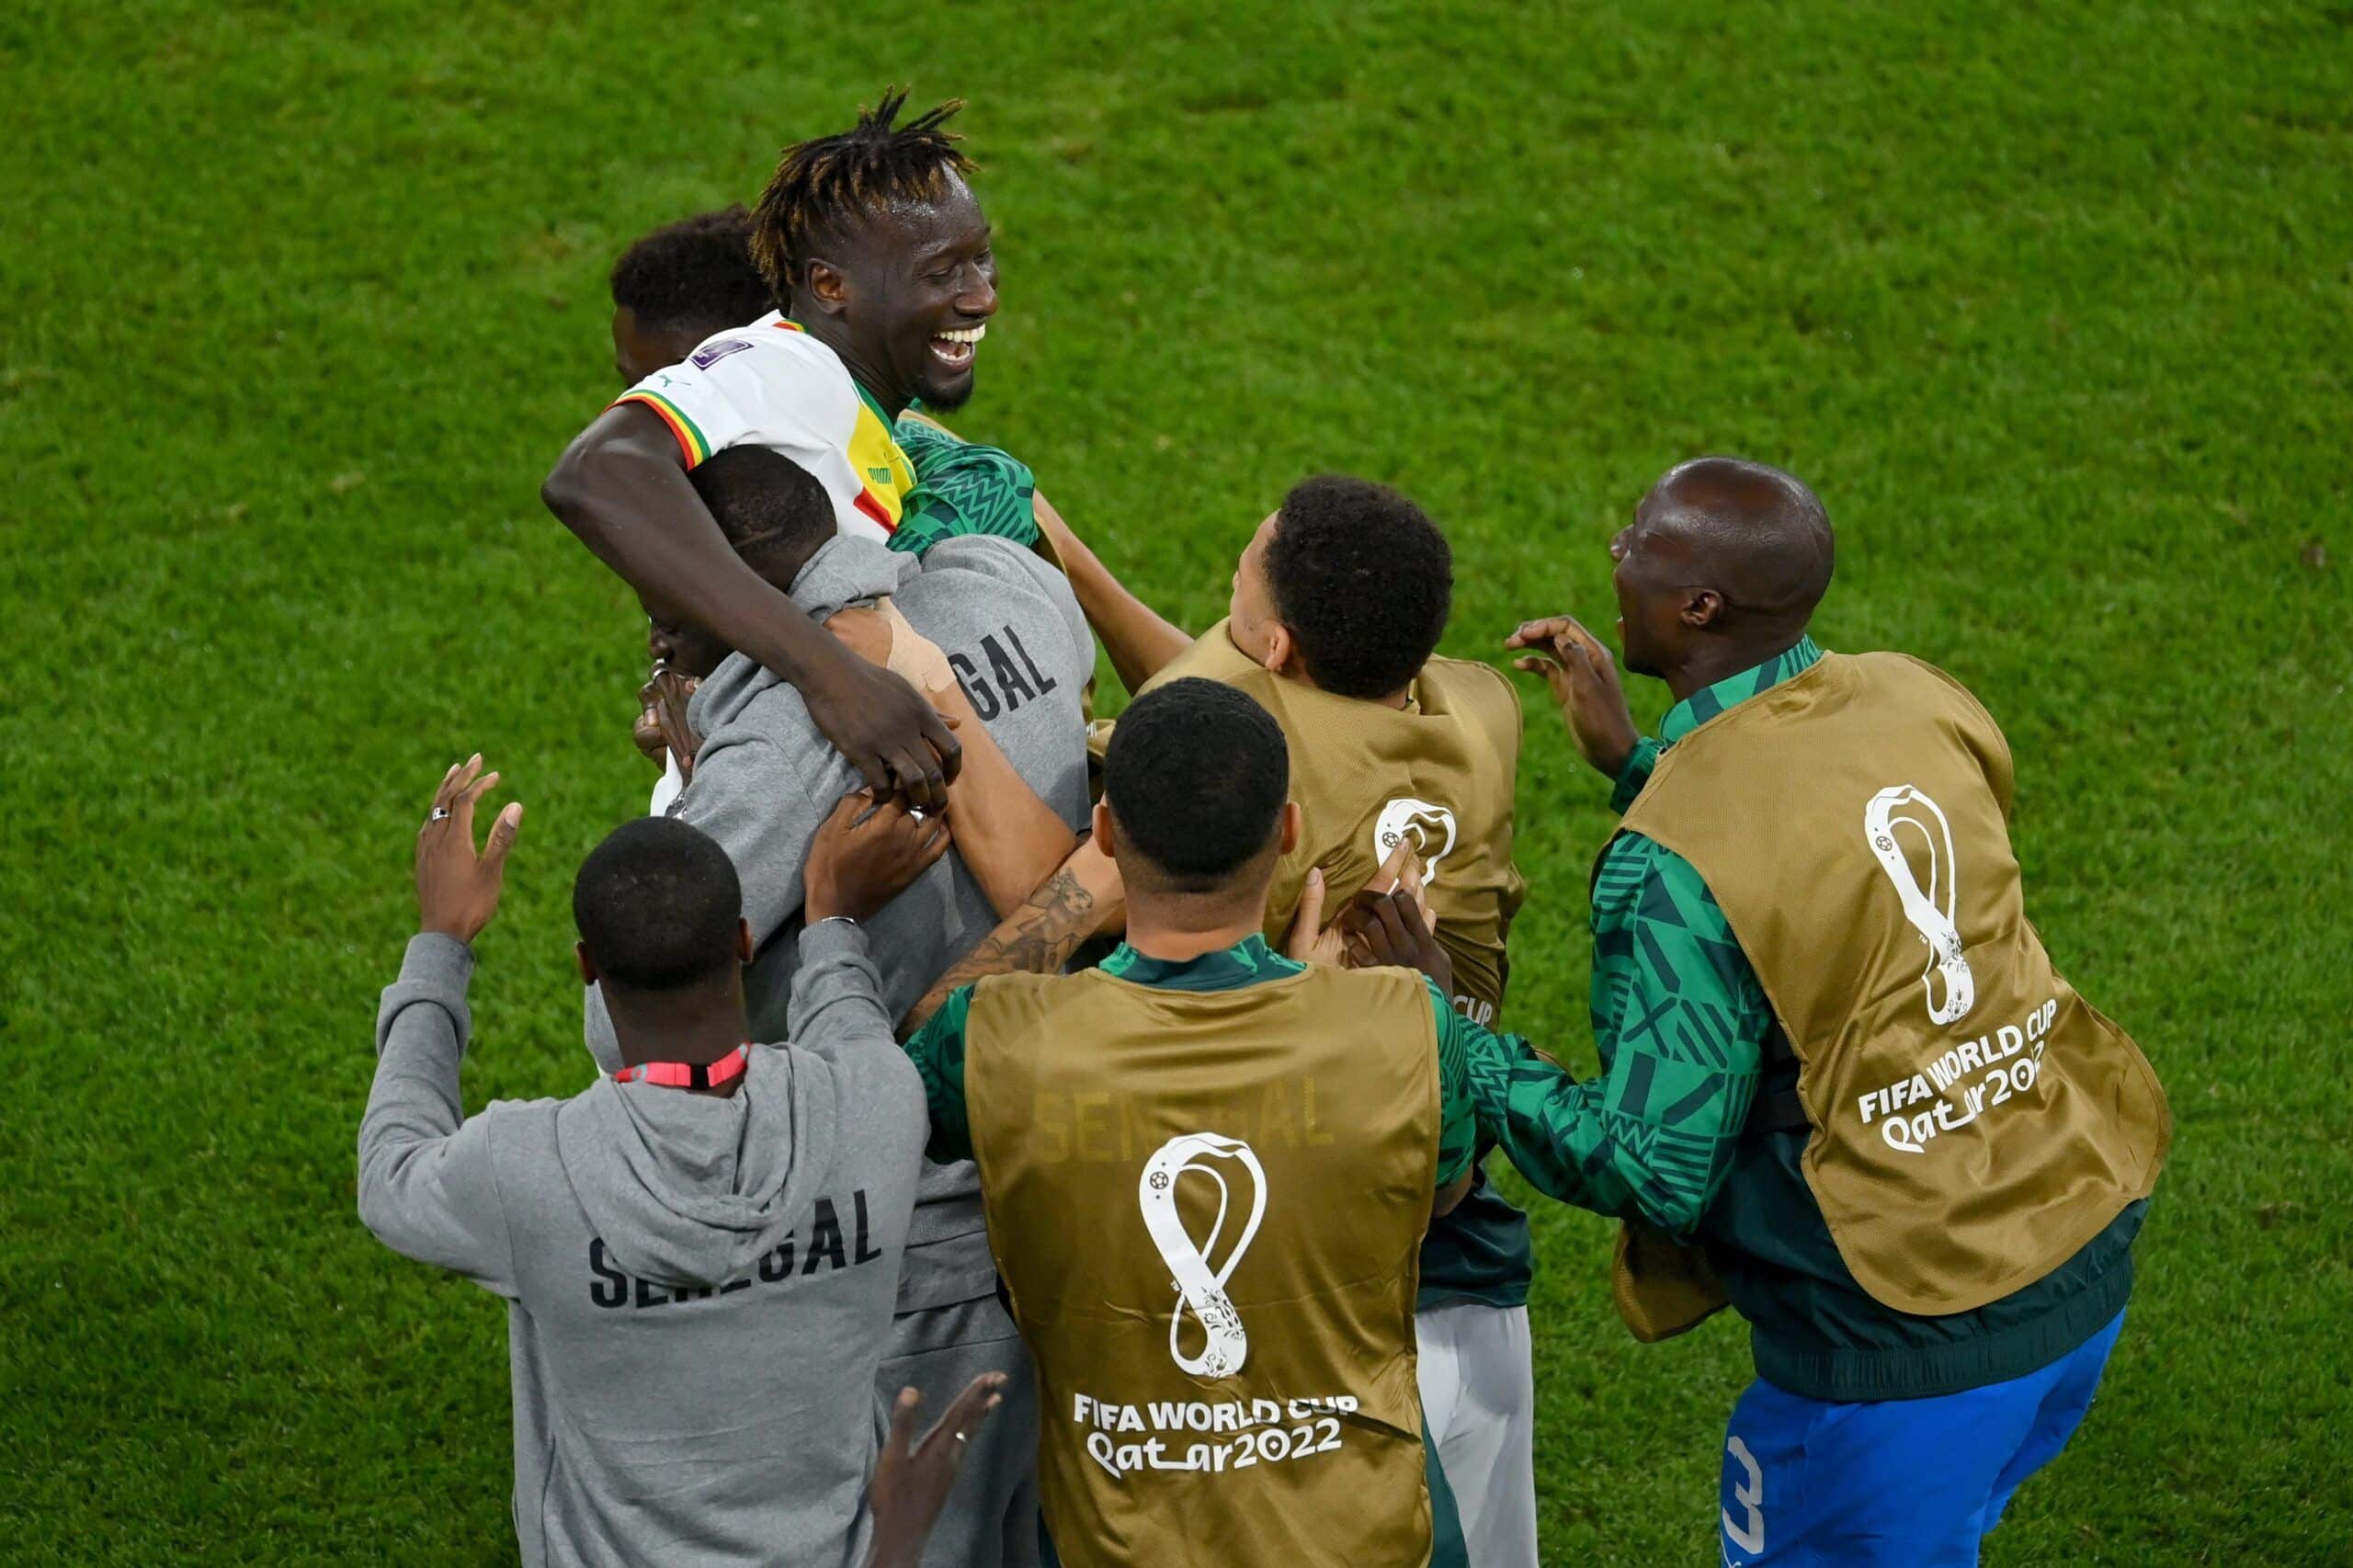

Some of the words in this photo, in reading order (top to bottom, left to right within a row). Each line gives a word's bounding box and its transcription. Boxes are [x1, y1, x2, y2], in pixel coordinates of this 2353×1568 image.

[1858, 1073, 1934, 1124] FIFA
[1927, 1025, 2024, 1092] WORLD
[2026, 998, 2057, 1042] CUP
[1881, 1040, 2045, 1154] Qatar202
[1074, 1392, 1148, 1432] FIFA
[1147, 1400, 1281, 1432] WORLD
[1288, 1395, 1358, 1419] CUP
[1086, 1417, 1343, 1479] Qatar2022
[1722, 1435, 1765, 1555] 3
